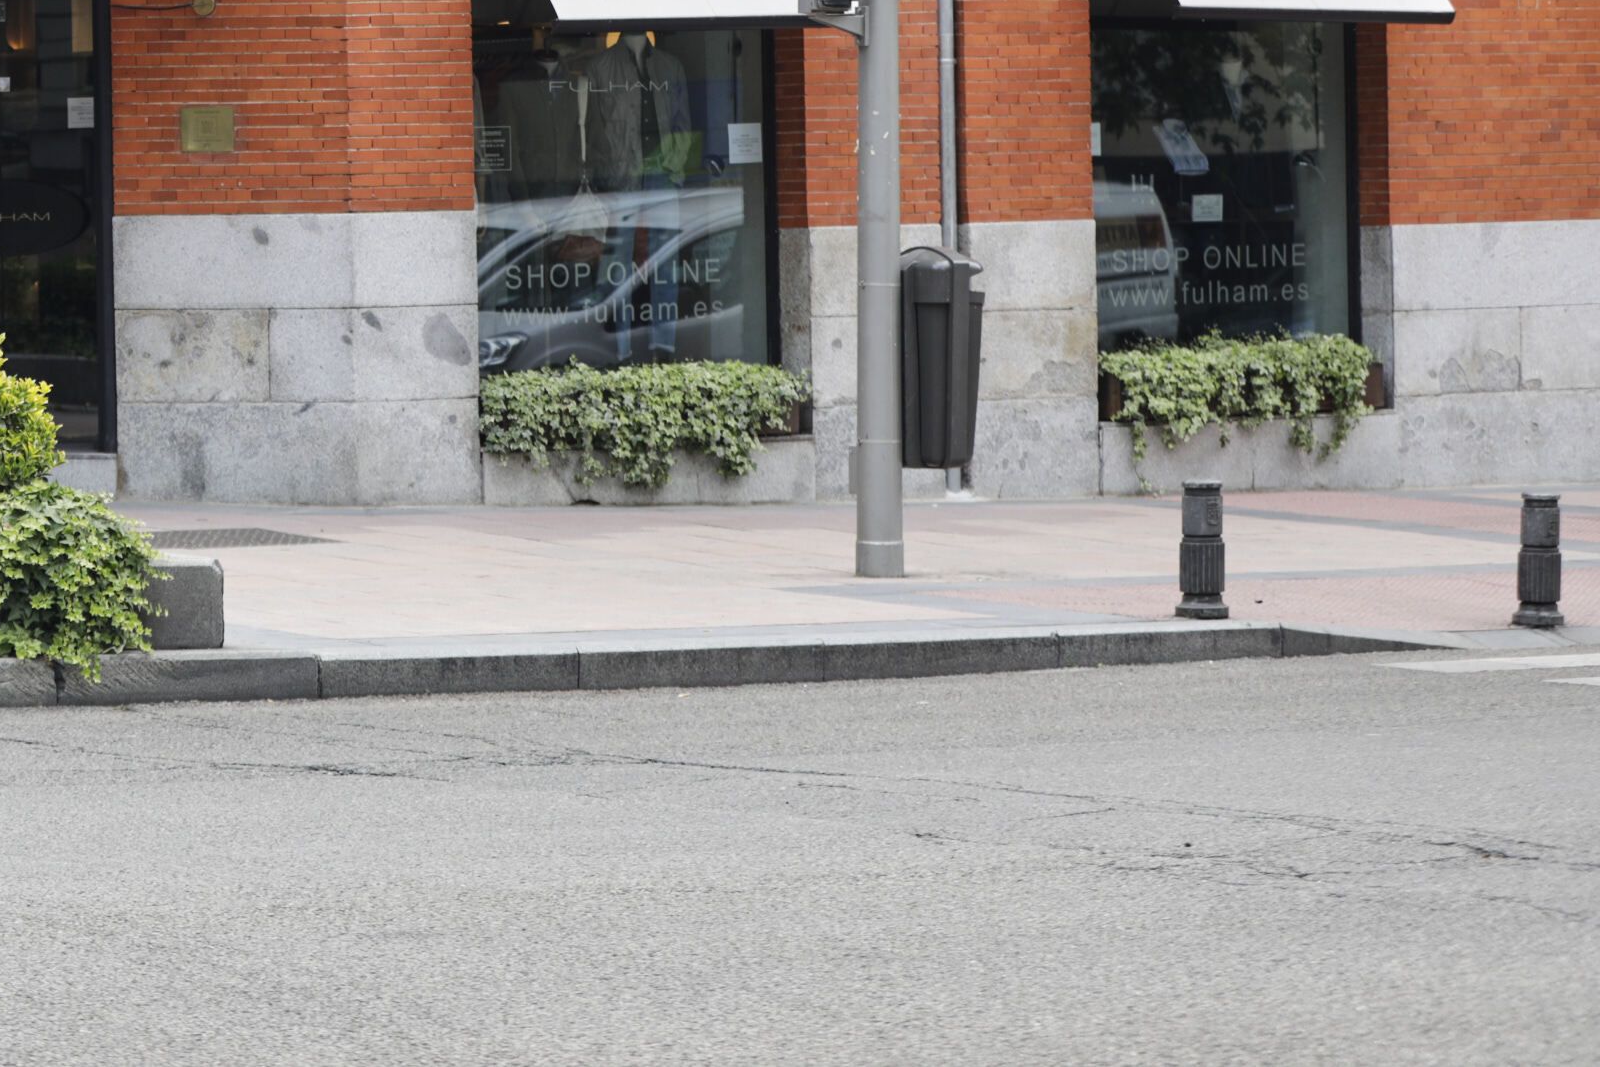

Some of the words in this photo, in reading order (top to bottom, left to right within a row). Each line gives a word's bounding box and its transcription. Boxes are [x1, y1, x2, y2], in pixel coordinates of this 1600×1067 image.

[548, 80, 669, 93] FULHAM
[1112, 246, 1190, 273] SHOP
[1203, 243, 1306, 269] ONLINE
[505, 262, 591, 290] SHOP
[606, 258, 721, 286] ONLINE
[1110, 279, 1310, 308] www.fulham.es
[503, 298, 725, 327] www.fulham.es
